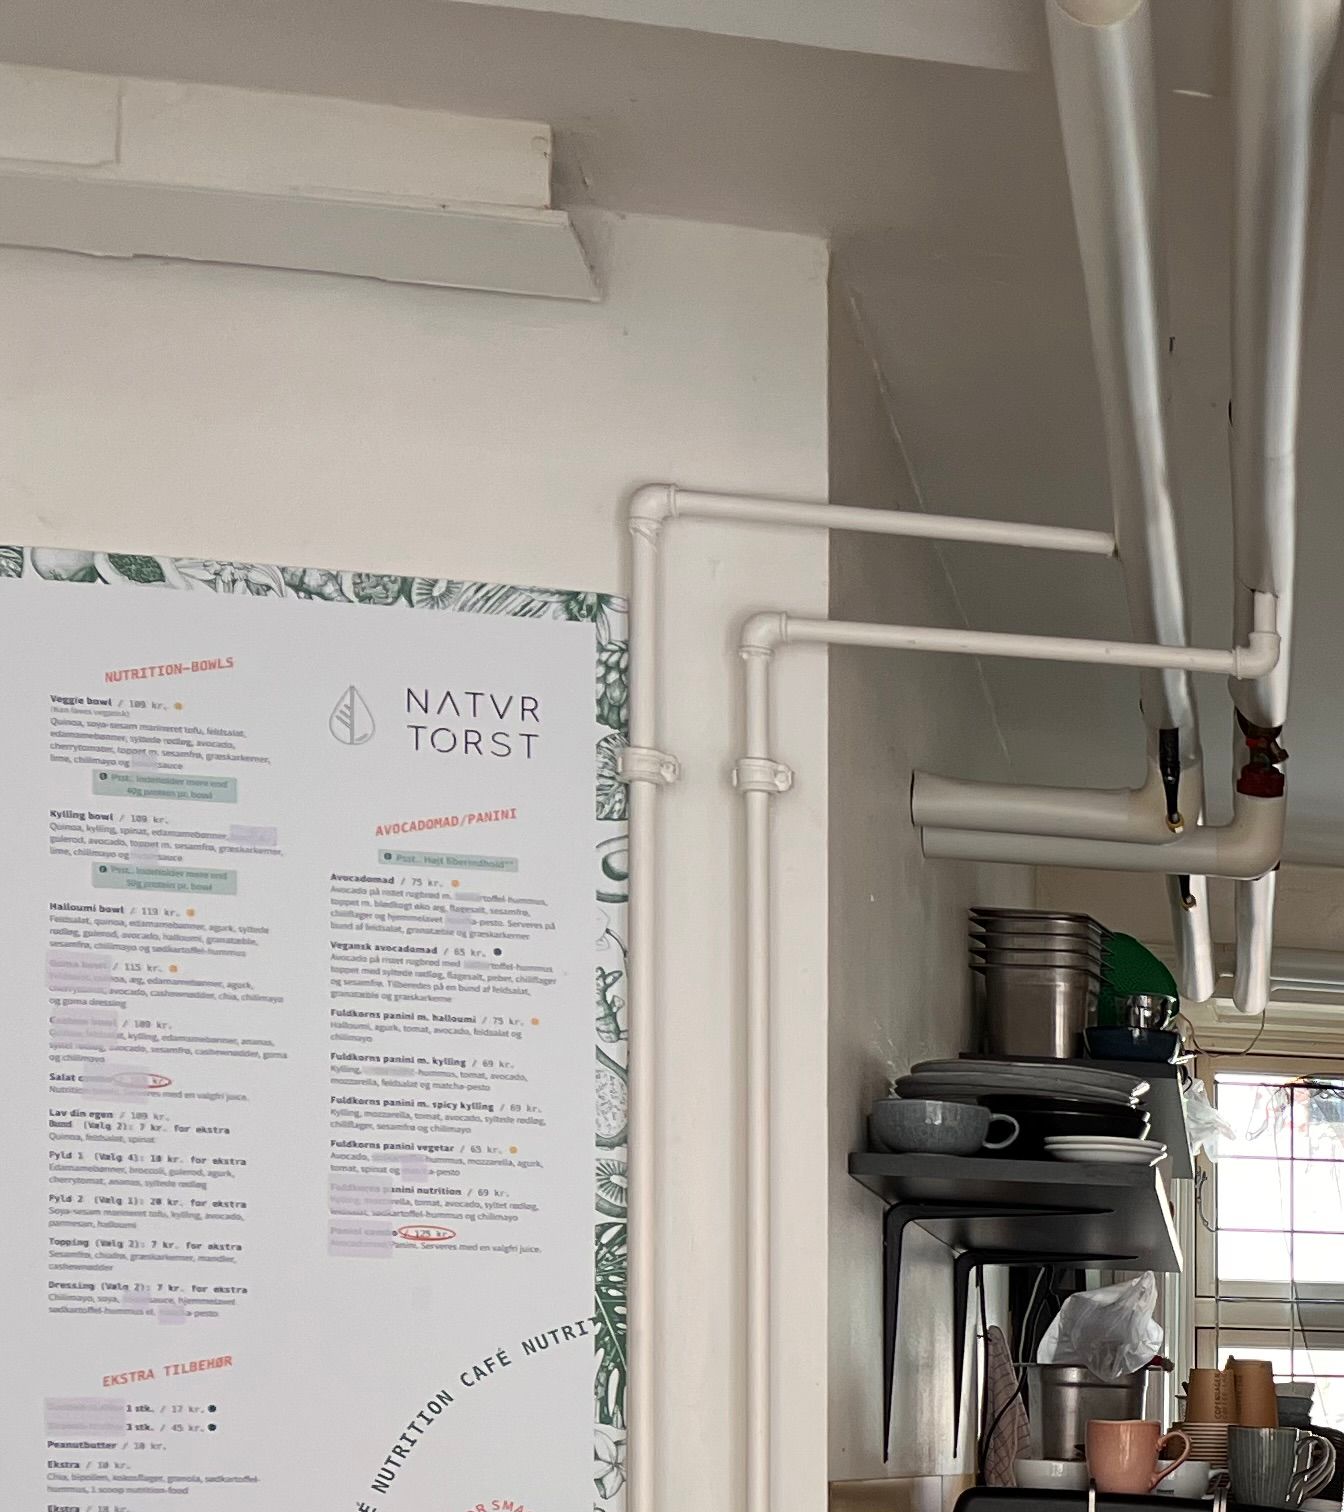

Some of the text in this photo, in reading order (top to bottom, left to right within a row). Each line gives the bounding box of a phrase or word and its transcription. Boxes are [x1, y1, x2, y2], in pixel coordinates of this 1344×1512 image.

[50, 694, 112, 707] Veggie bowl
[407, 725, 540, 759] TORST
[376, 808, 517, 837] AVOCADOMAD/PANINI
[330, 873, 394, 885] Avocadomad
[50, 902, 124, 914] Halloumi bowl
[103, 1355, 233, 1387] EKSTRA TILBEHØR
[371, 1390, 454, 1494] NUTRITION
[459, 1347, 512, 1389] CAFÉ
[47, 1441, 117, 1450] Peanutbutter
